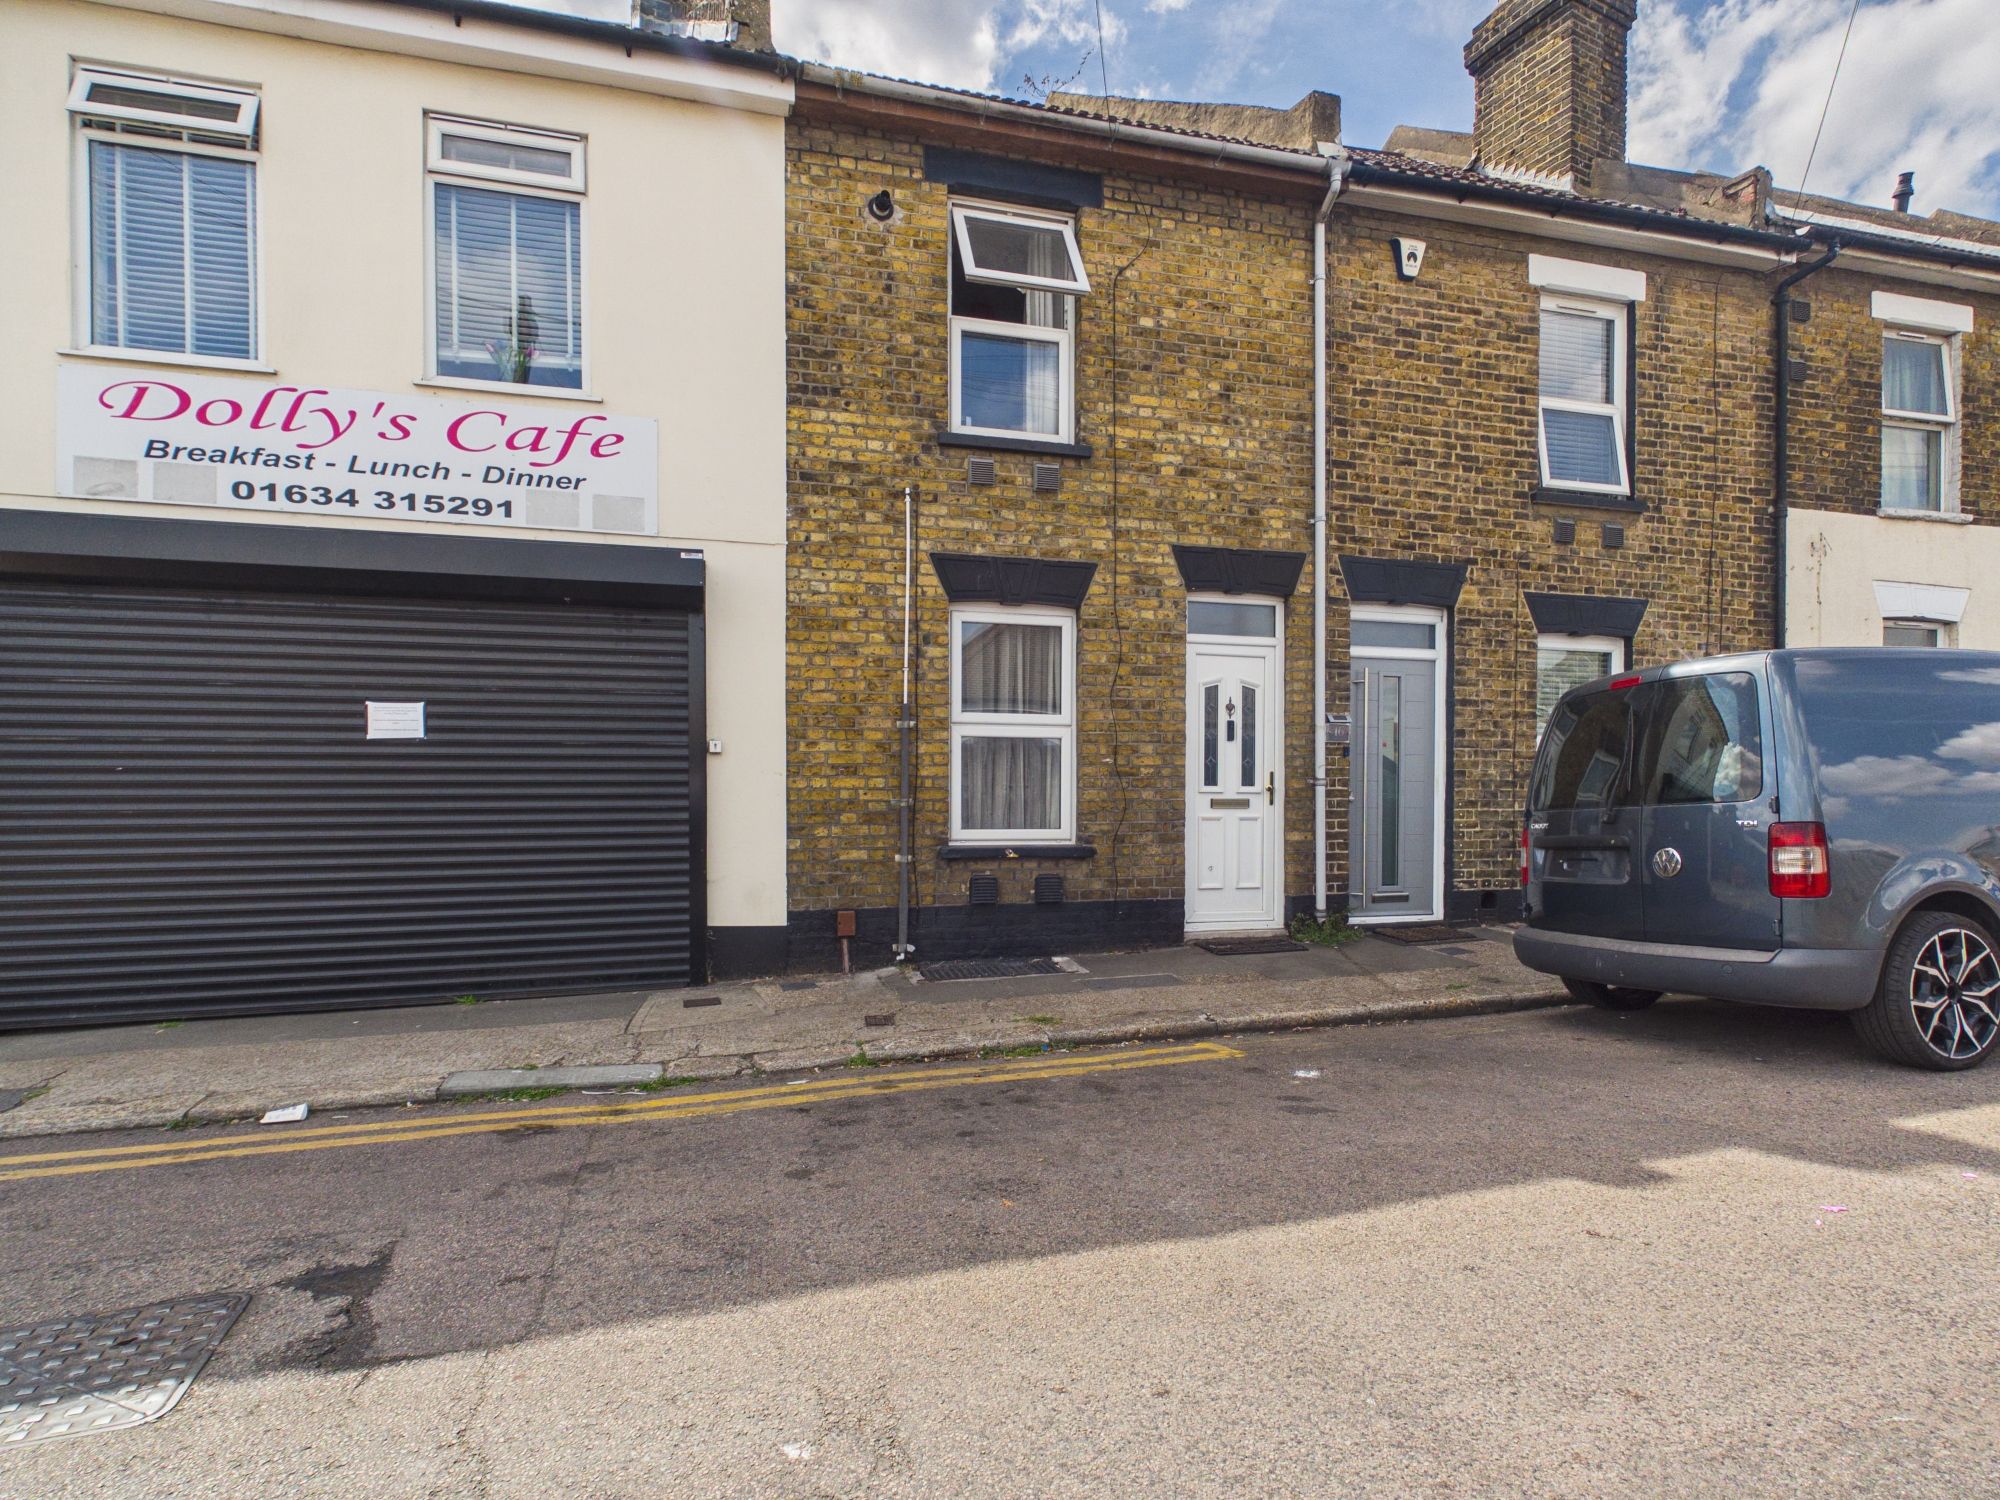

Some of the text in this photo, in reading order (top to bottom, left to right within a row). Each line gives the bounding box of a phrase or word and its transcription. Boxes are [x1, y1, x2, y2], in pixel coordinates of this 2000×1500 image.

[98, 381, 626, 468] Dolly's Cafe
[144, 439, 316, 471] Breakfast
[347, 455, 451, 481] Lunch
[482, 465, 588, 491] Dinner
[231, 481, 513, 518] 01634 315291
